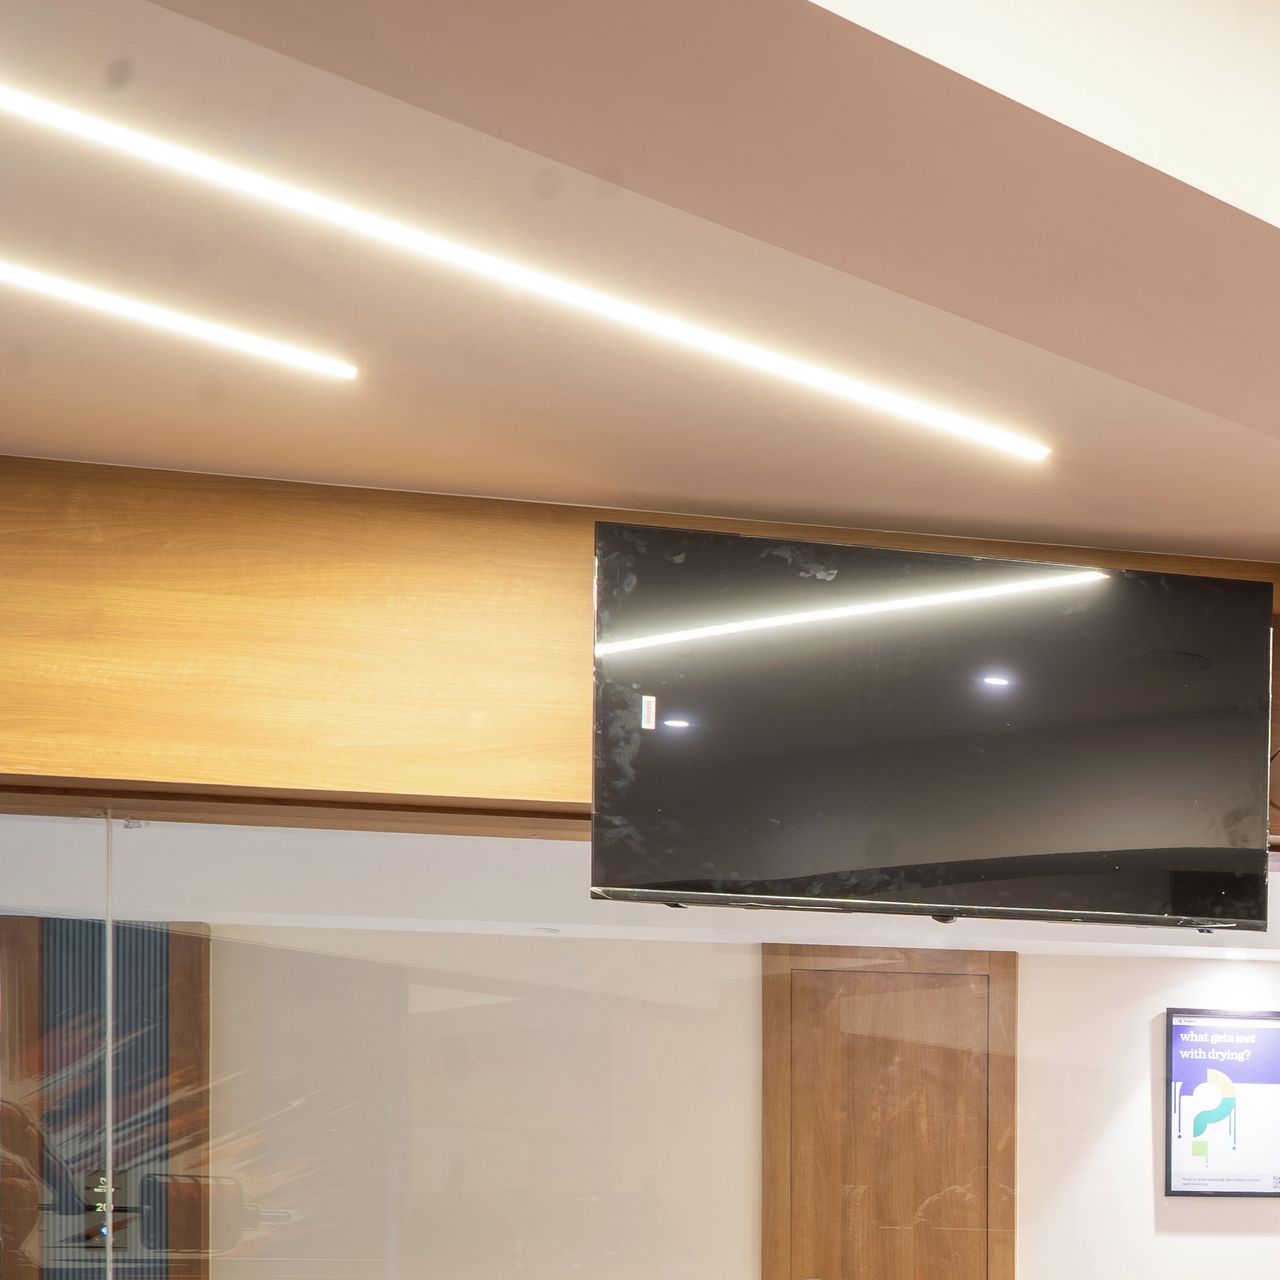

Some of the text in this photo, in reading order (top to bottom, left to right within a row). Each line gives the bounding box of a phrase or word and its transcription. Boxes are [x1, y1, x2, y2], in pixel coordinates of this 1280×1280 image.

[1179, 1031, 1209, 1043] what
[1210, 1034, 1233, 1045] gets
[1179, 1048, 1252, 1062] with drying?
